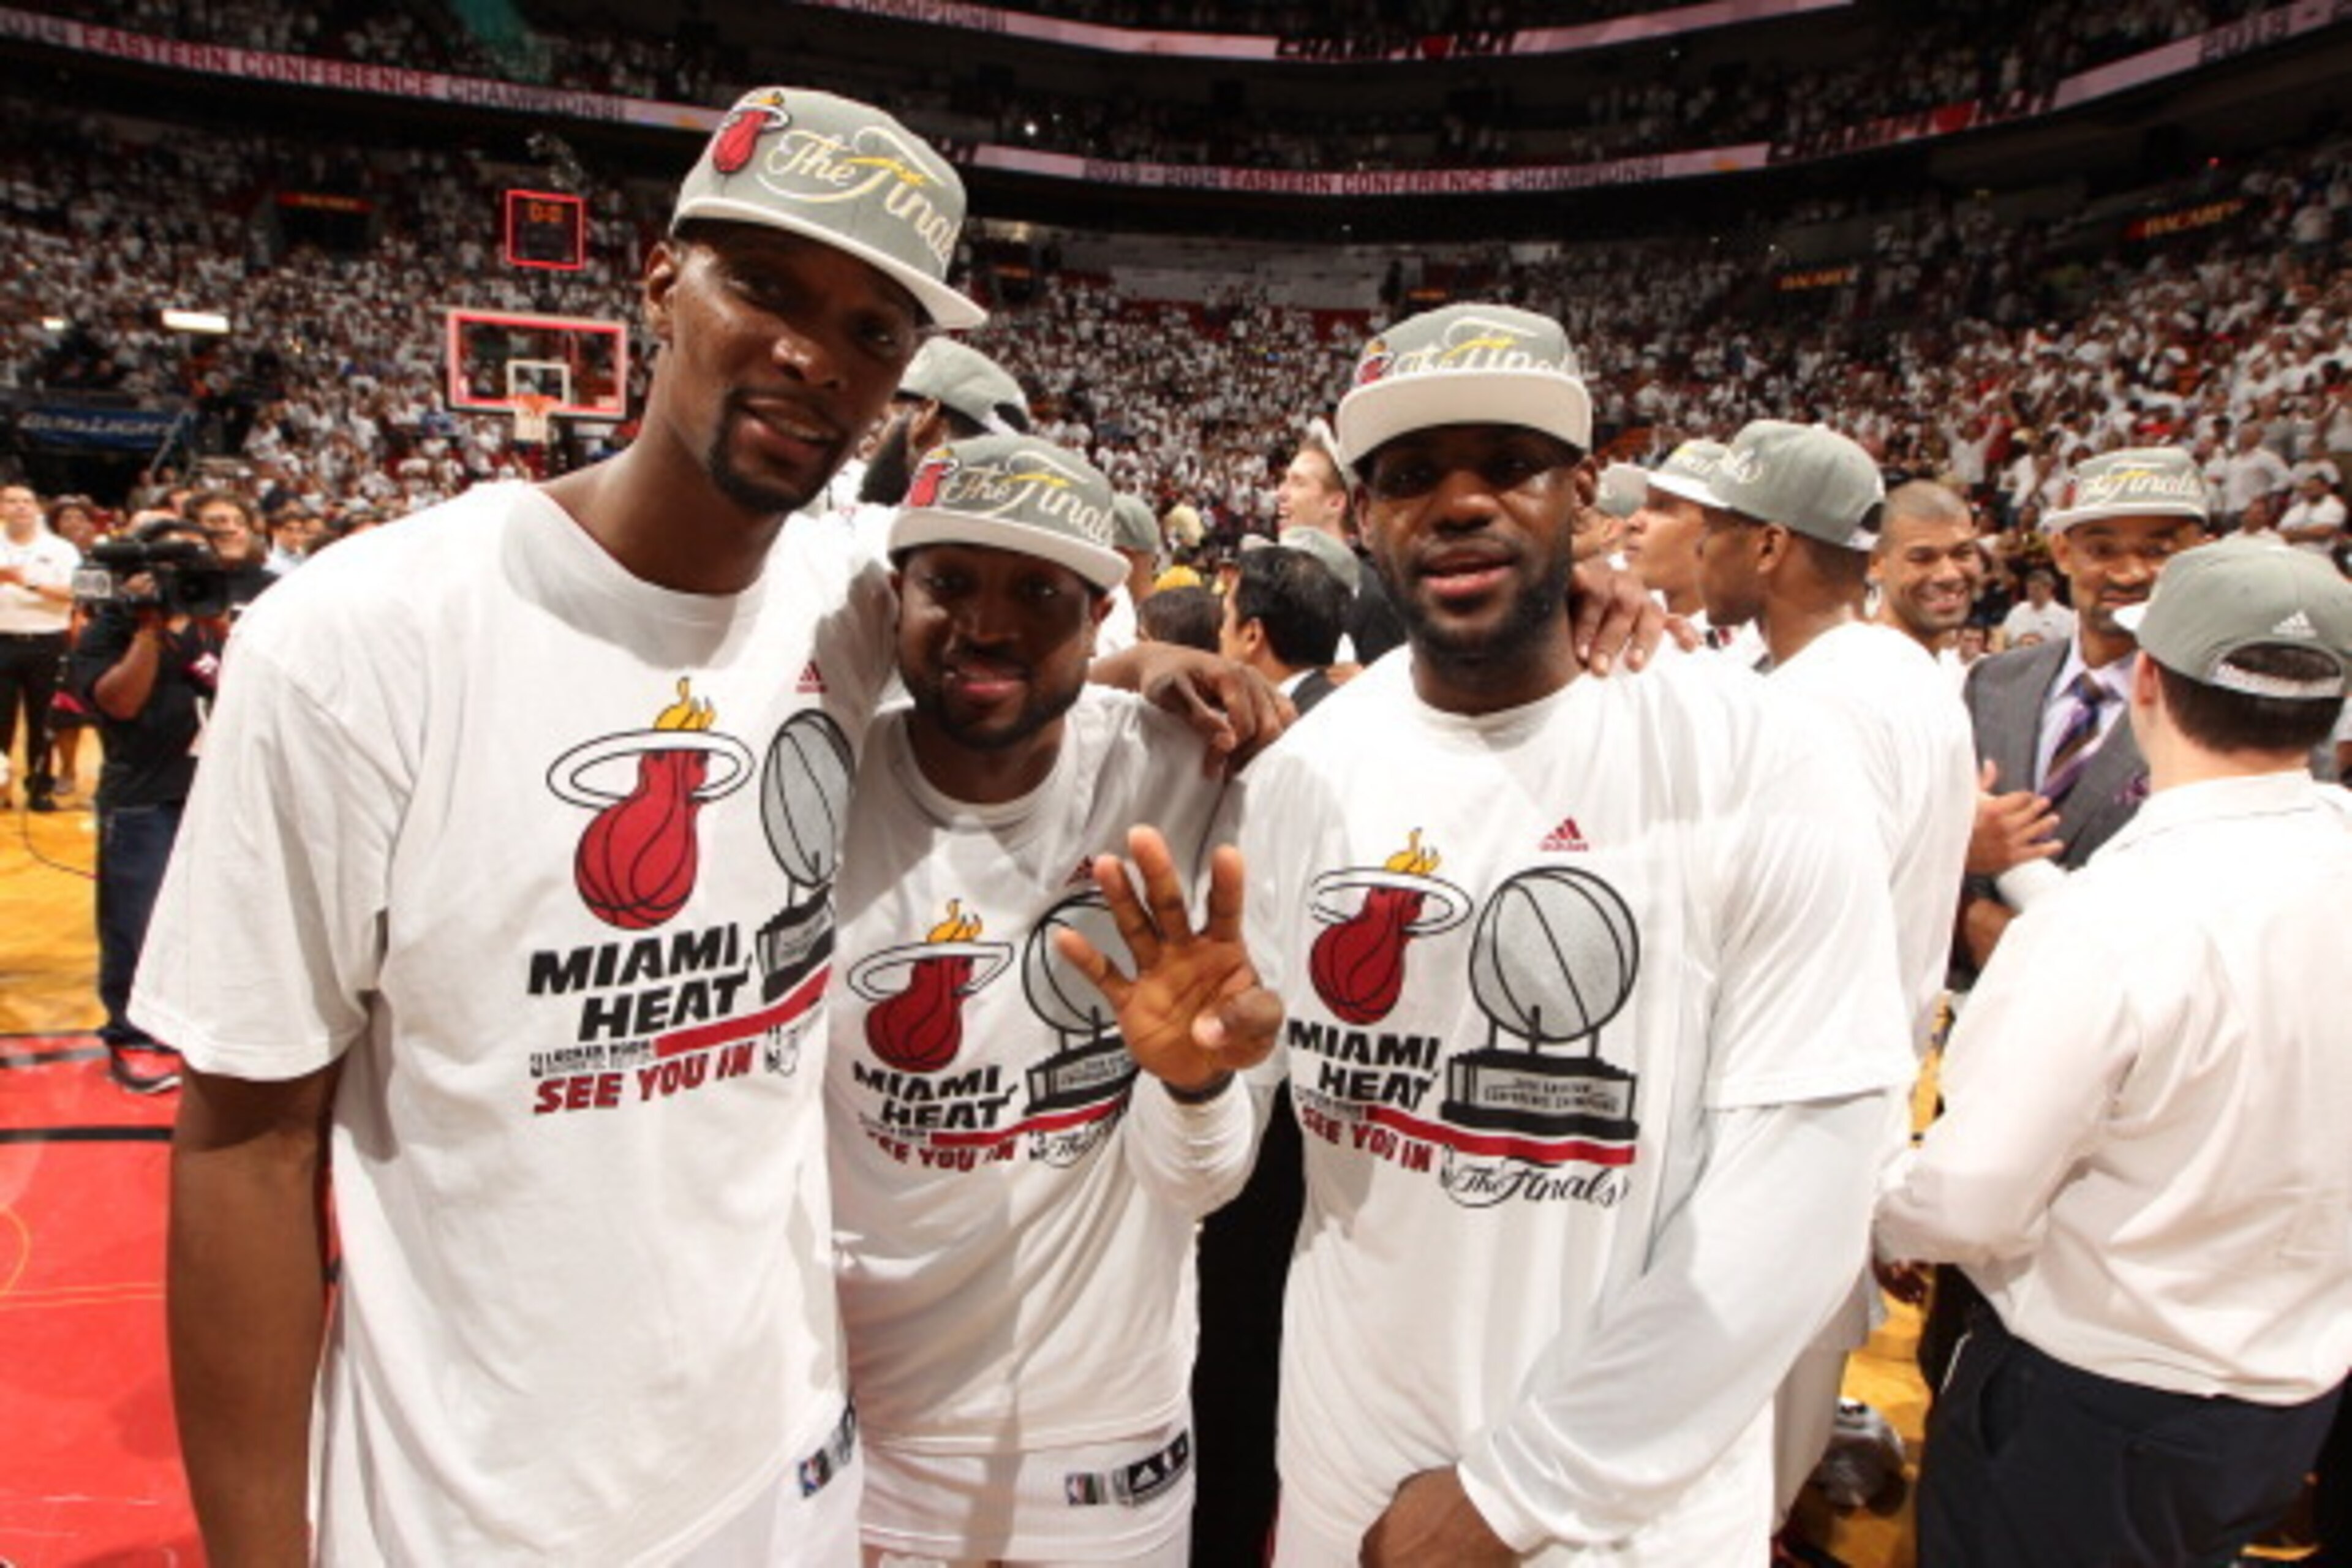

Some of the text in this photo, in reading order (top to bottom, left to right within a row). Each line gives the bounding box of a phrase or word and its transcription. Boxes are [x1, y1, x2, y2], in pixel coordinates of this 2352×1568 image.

[81, 23, 229, 72] EASTERN
[243, 51, 432, 96] CONFERENCE
[766, 126, 960, 262] The Final
[1227, 167, 1330, 193] EASTERN
[1343, 169, 1497, 194] CONFERENCE
[938, 462, 1012, 505] The
[528, 922, 737, 995] MIAMI
[578, 957, 752, 1041] HEAT
[1287, 1018, 1441, 1070] MIAMI
[533, 1073, 623, 1114] SEE
[637, 1054, 709, 1101] YOU
[717, 1042, 755, 1080] IN
[853, 1061, 1001, 1101] MIAMI
[1318, 1060, 1437, 1112] HEAT
[881, 1084, 1018, 1128] HEAT
[918, 1148, 978, 1172] YOU
[1351, 1123, 1398, 1161] YOU
[1401, 1140, 1433, 1172] IN
[1482, 1155, 1627, 1208] Finals
